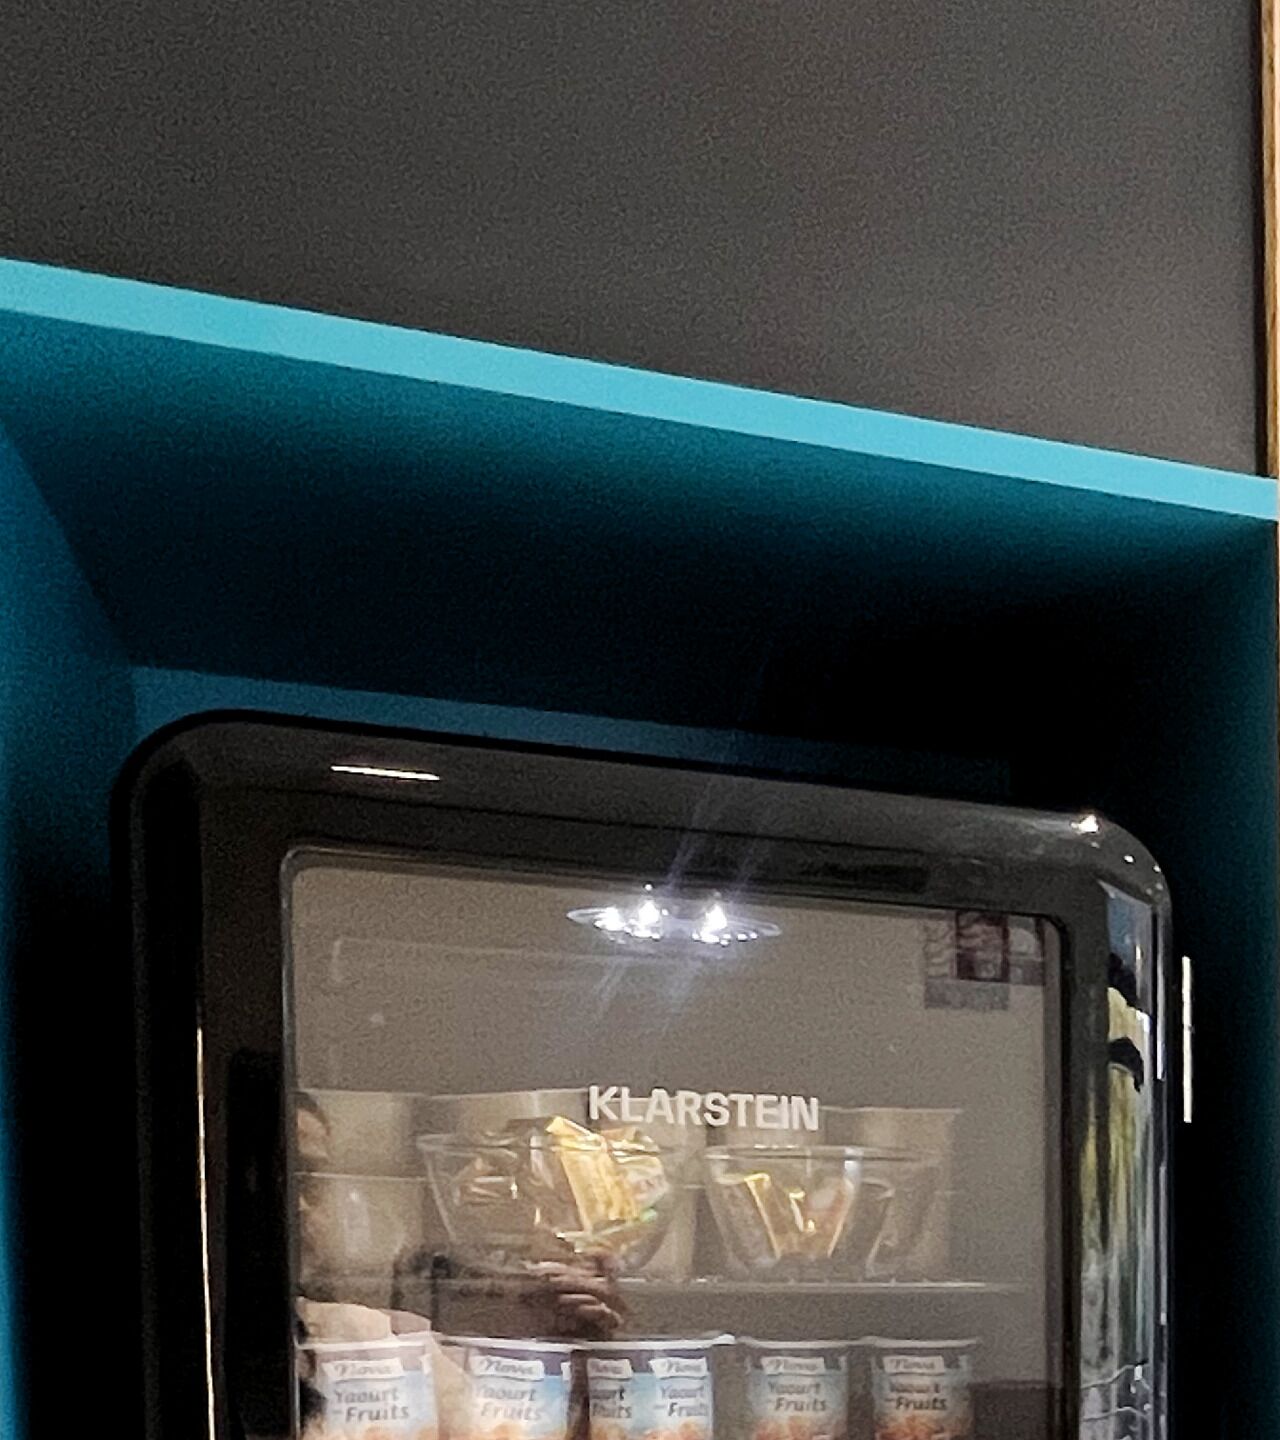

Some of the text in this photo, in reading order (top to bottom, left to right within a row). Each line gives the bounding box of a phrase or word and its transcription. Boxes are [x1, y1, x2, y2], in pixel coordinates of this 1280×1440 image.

[588, 1085, 820, 1131] KLARSTEIN
[333, 1387, 400, 1404] Yaourt
[481, 1404, 544, 1421] Fruits
[774, 1397, 827, 1412] Fruits
[344, 1405, 410, 1423] Fruits
